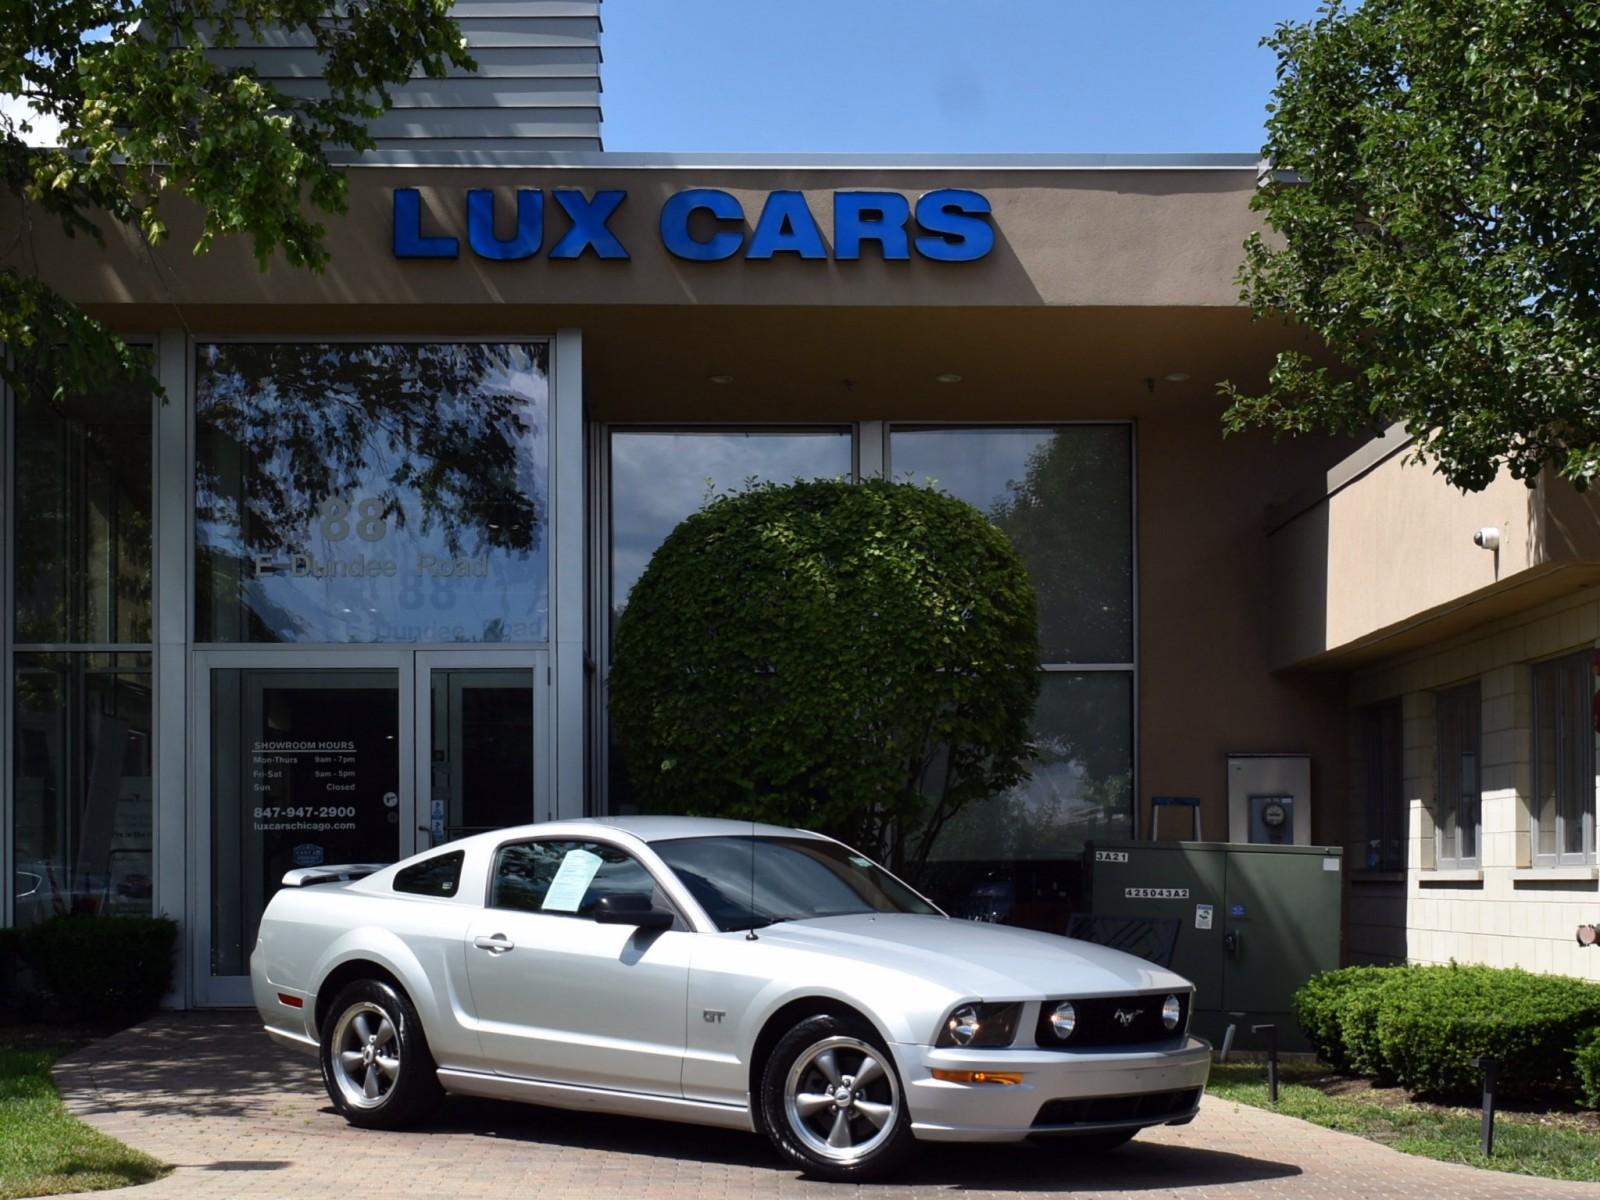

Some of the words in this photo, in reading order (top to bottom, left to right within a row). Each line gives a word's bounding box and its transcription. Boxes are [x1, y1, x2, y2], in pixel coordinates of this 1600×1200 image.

[391, 187, 630, 262] LUX
[659, 187, 995, 263] CARS
[320, 497, 386, 541] 88
[255, 553, 273, 577] E
[291, 552, 397, 578] Dundee
[416, 553, 488, 577] Road
[254, 741, 316, 750] SHOWROOM
[318, 741, 355, 750] HOURS
[253, 756, 298, 764] Mon-Thurs
[314, 756, 332, 764] 9am
[338, 756, 356, 764] 7pm
[253, 770, 283, 778] Fri-Sat
[253, 783, 271, 791] Sun
[326, 783, 356, 791] Closed
[253, 806, 356, 818] 847-947-2900
[253, 821, 356, 832] luxcarschicago.com
[1096, 852, 1127, 862] 3A21
[1126, 889, 1188, 898] 425043A2
[703, 1008, 726, 1024] GT
